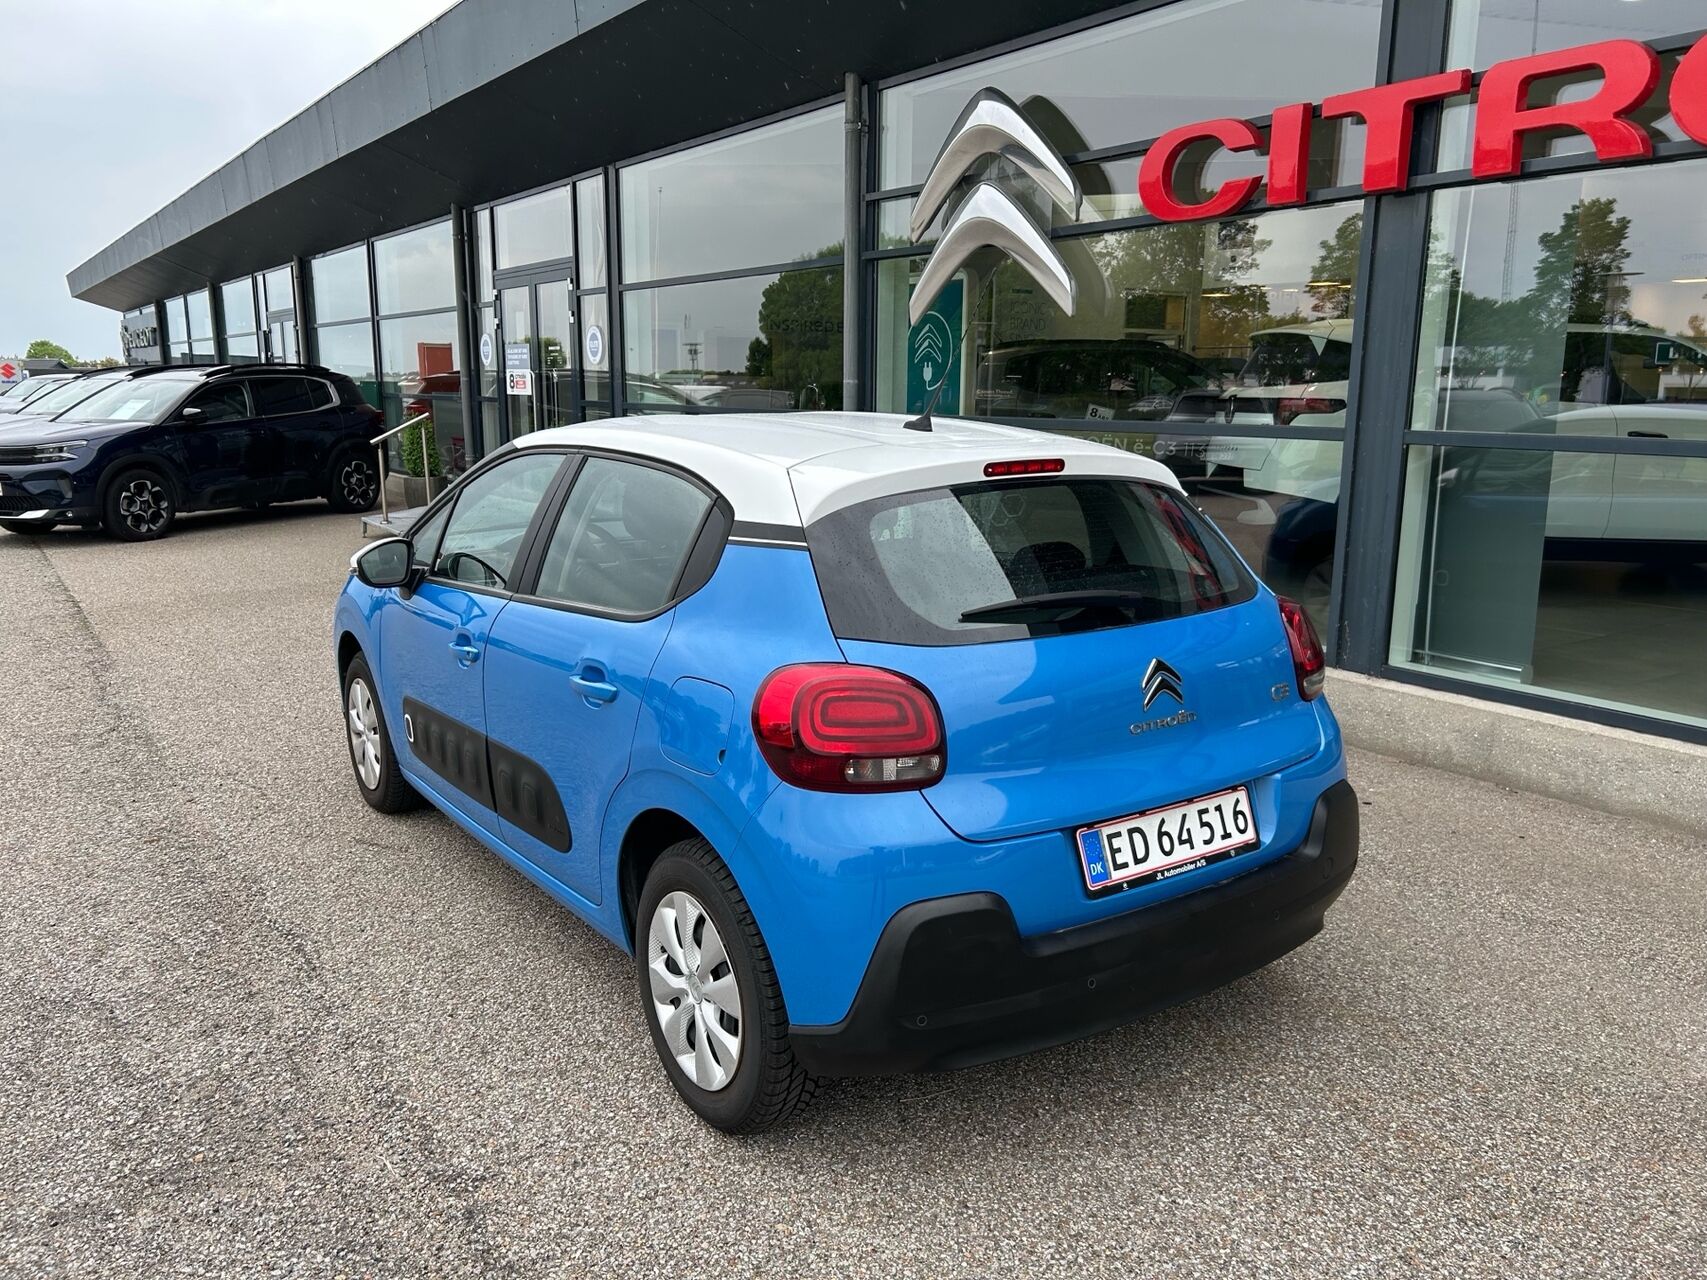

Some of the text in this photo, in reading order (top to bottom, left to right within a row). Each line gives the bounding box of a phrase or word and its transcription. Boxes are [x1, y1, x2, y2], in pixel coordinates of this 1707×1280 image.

[1009, 317, 1047, 331] BRAND
[1090, 407, 1098, 418] 8
[1271, 683, 1290, 702] C3
[1106, 797, 1249, 871] ED 64 516
[1090, 863, 1104, 876] DK
[1164, 863, 1196, 878] Automobiler
